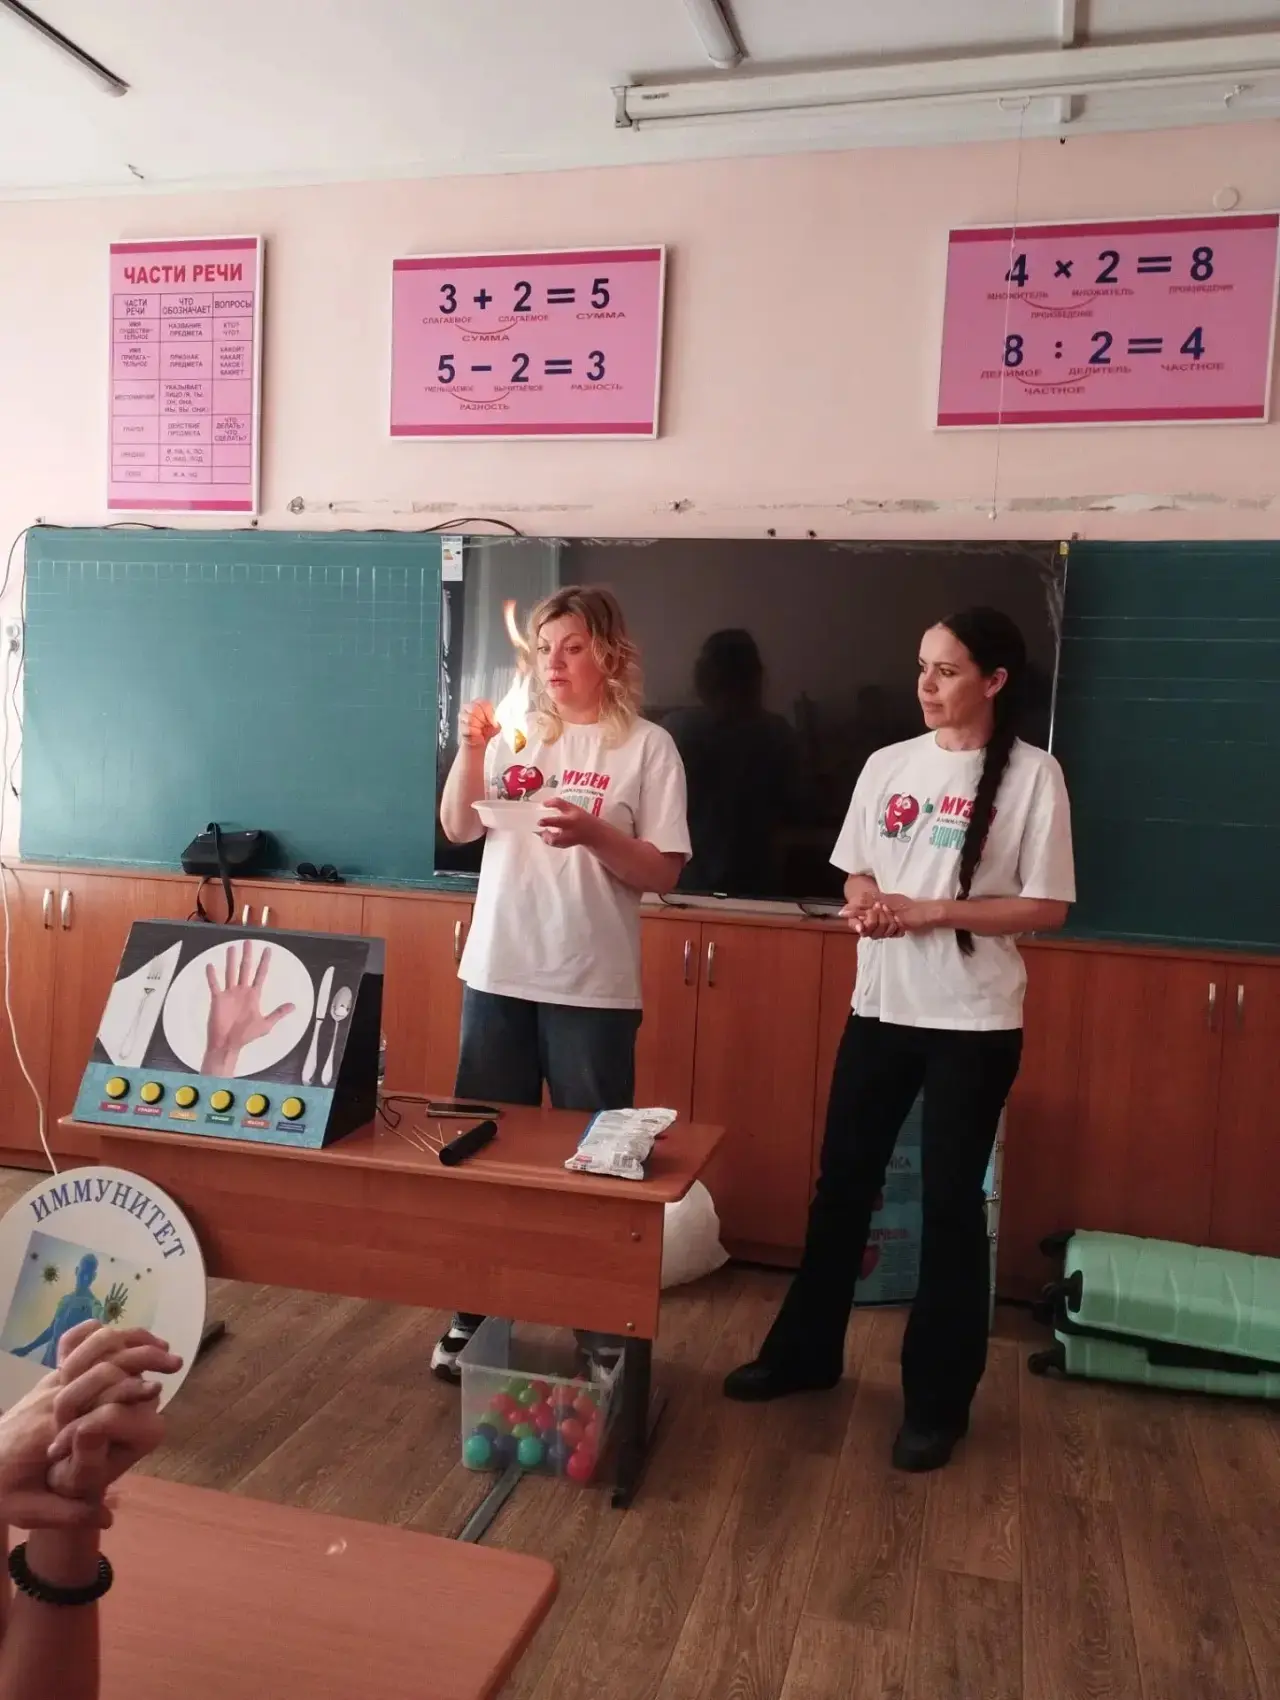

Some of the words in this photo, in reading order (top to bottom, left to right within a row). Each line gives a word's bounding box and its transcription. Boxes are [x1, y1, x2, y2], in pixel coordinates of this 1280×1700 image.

[1005, 253, 1029, 288] 4
[1095, 250, 1120, 284] 2
[1136, 255, 1172, 274] =
[1190, 246, 1214, 282] 8
[124, 265, 186, 284] ЧАСТИ
[192, 263, 242, 282] РЕЧИ
[439, 283, 457, 314] 3
[473, 288, 492, 310] +
[513, 281, 532, 312] 2
[547, 288, 575, 304] =
[591, 278, 610, 309] 5
[124, 299, 147, 307] ЧАСТИ
[179, 298, 194, 306] ЧТО
[214, 300, 252, 309] ВОПРОСЫ
[126, 307, 145, 316] РЕЧИ
[163, 305, 211, 315] ОБОЗНАЧАЕТ
[422, 316, 472, 325] СЛАГАЕМОЕ
[498, 314, 549, 323] СЛАГАЕМОЕ
[576, 311, 626, 320] СУММА
[462, 334, 510, 342] СУММА
[1004, 334, 1024, 368] 8
[1088, 330, 1113, 365] 2
[1127, 337, 1163, 354] =
[1180, 326, 1205, 361] 4
[437, 354, 456, 384] 5
[511, 352, 530, 383] 2
[544, 359, 572, 375] =
[586, 350, 605, 381] 3
[1068, 366, 1132, 376] ДЕЛИТЕЛЬ
[1160, 362, 1225, 372] ЧАСТНОЕ
[570, 383, 624, 391] РАЗНОСТЬ
[1023, 386, 1086, 396] ЧАСТНОЕ
[459, 403, 510, 411] РАЗНОСТЬ
[29, 1178, 186, 1260] ИММУНИТЕТ
